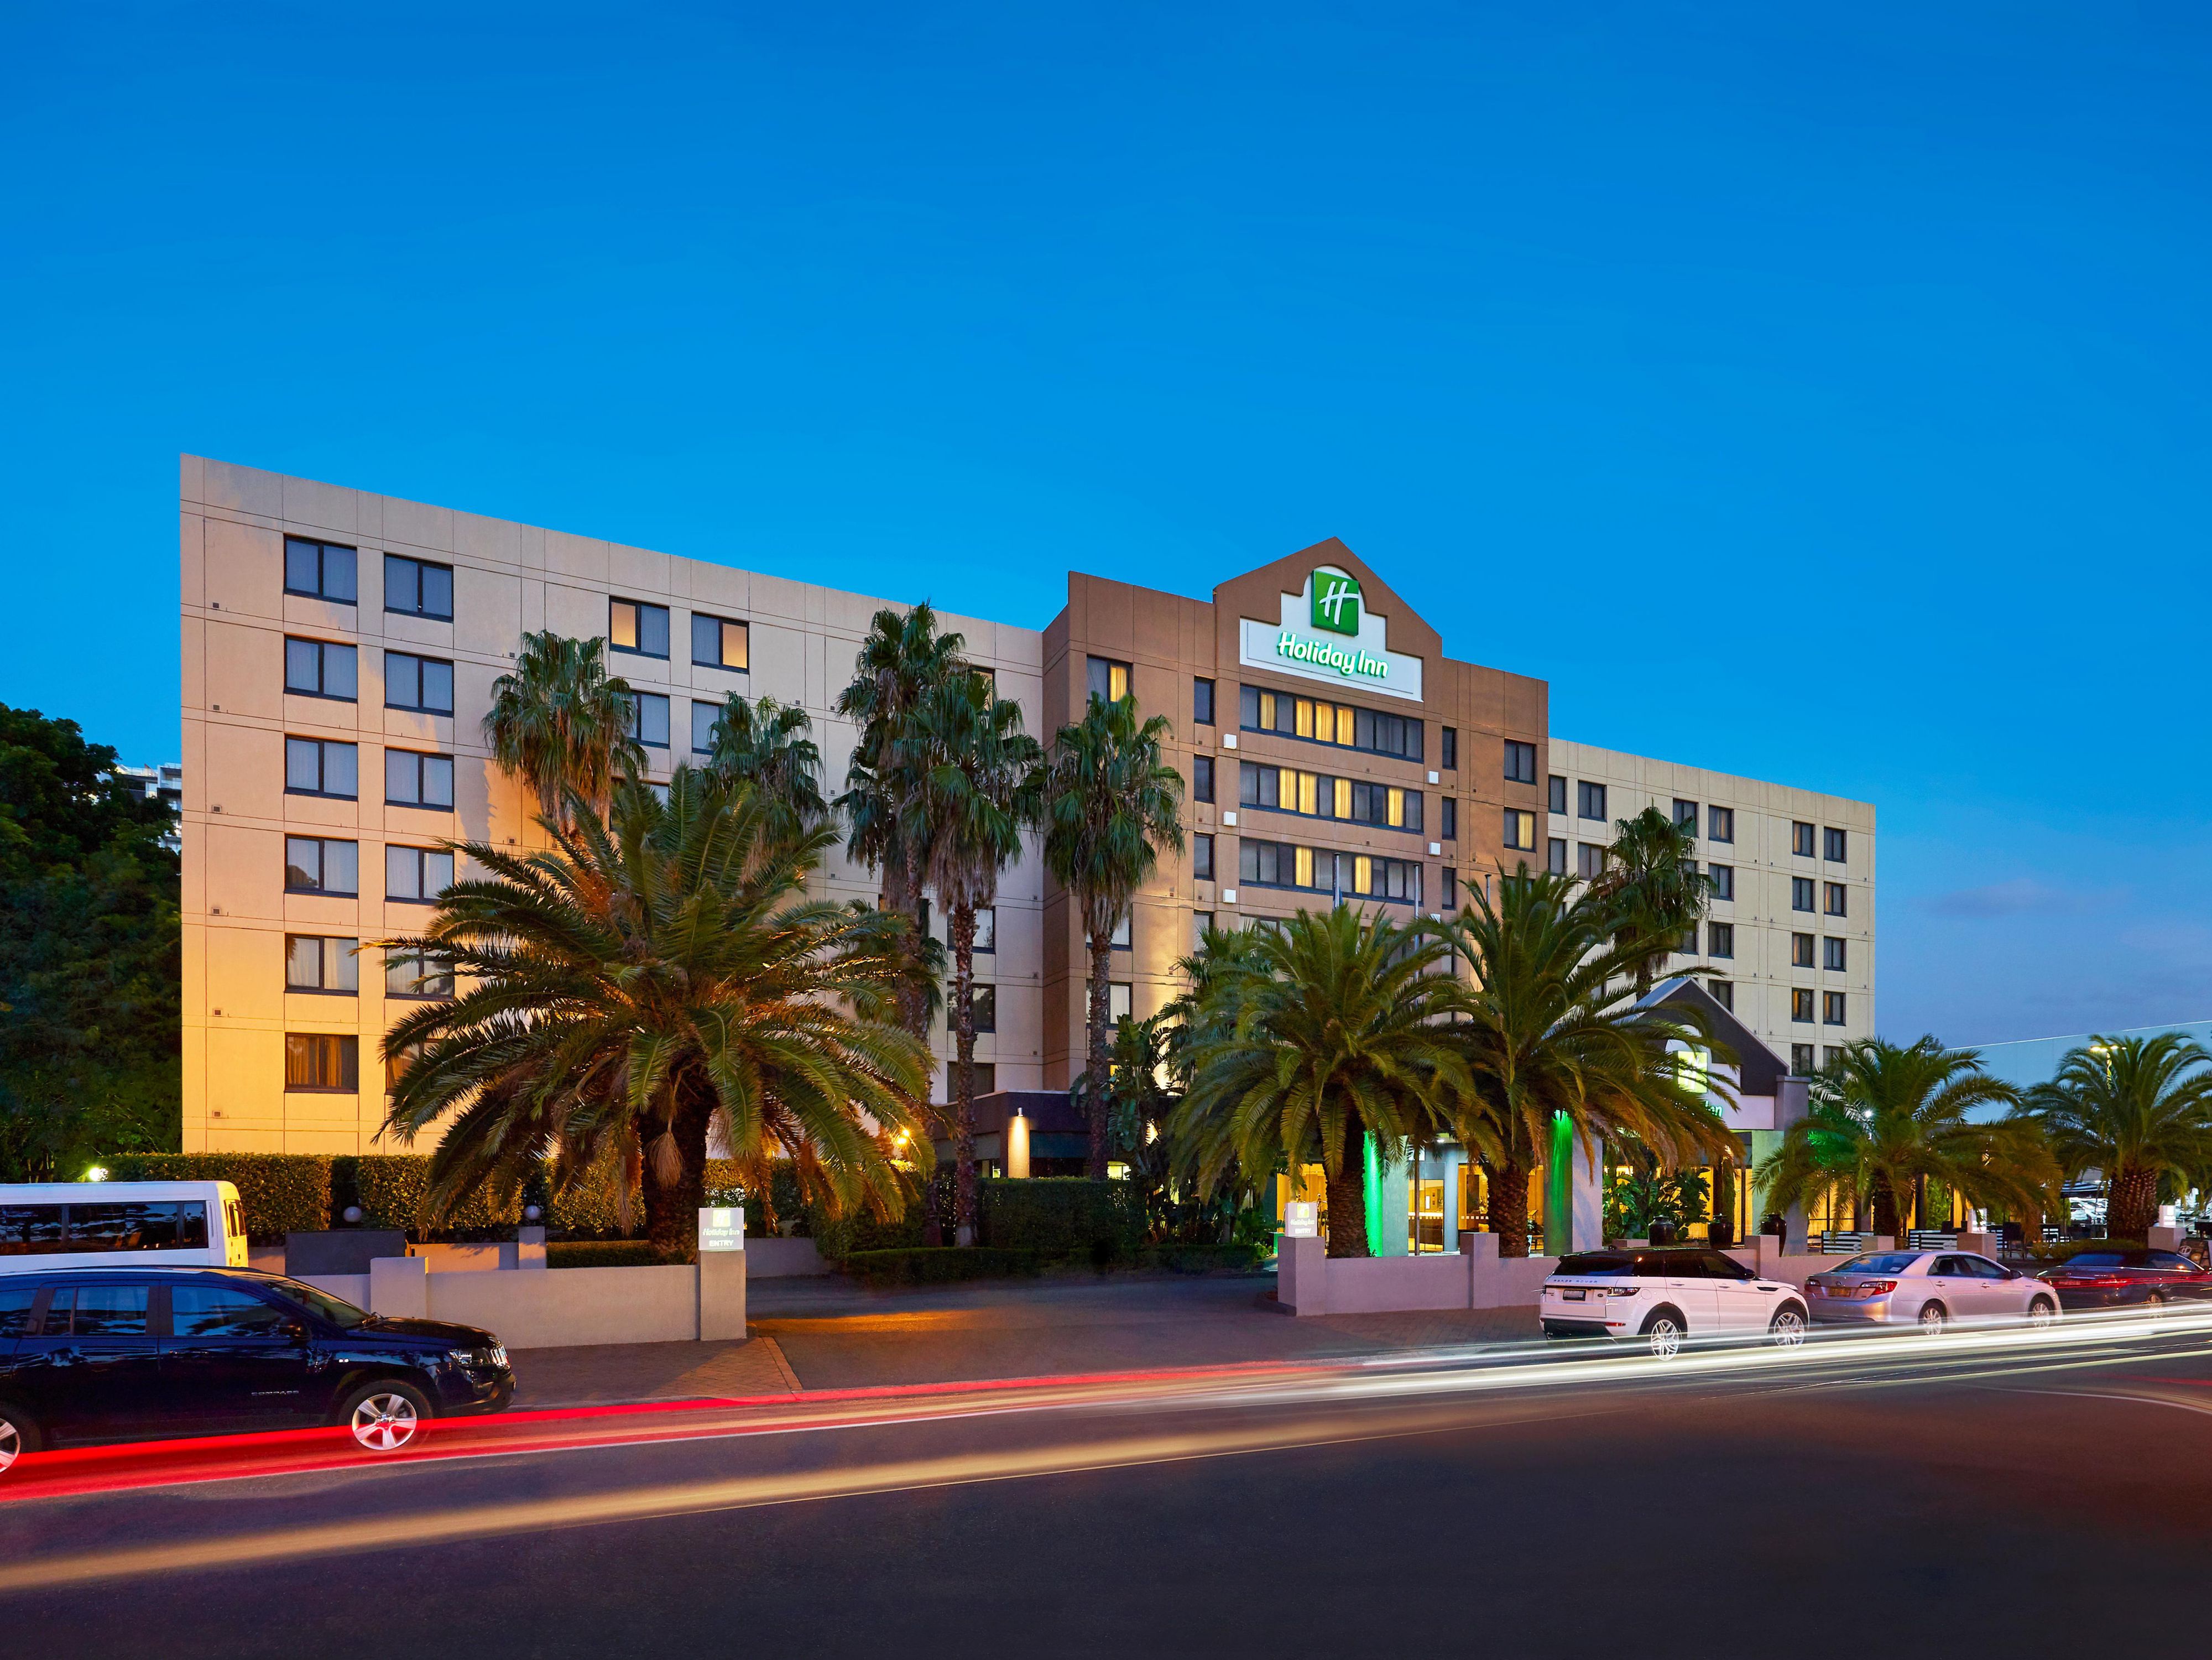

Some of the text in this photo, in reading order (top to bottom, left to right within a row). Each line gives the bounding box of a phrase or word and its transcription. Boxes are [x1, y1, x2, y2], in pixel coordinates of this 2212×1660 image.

[1279, 631, 1389, 678] Holiday Inn
[702, 1228, 729, 1236] Holiday
